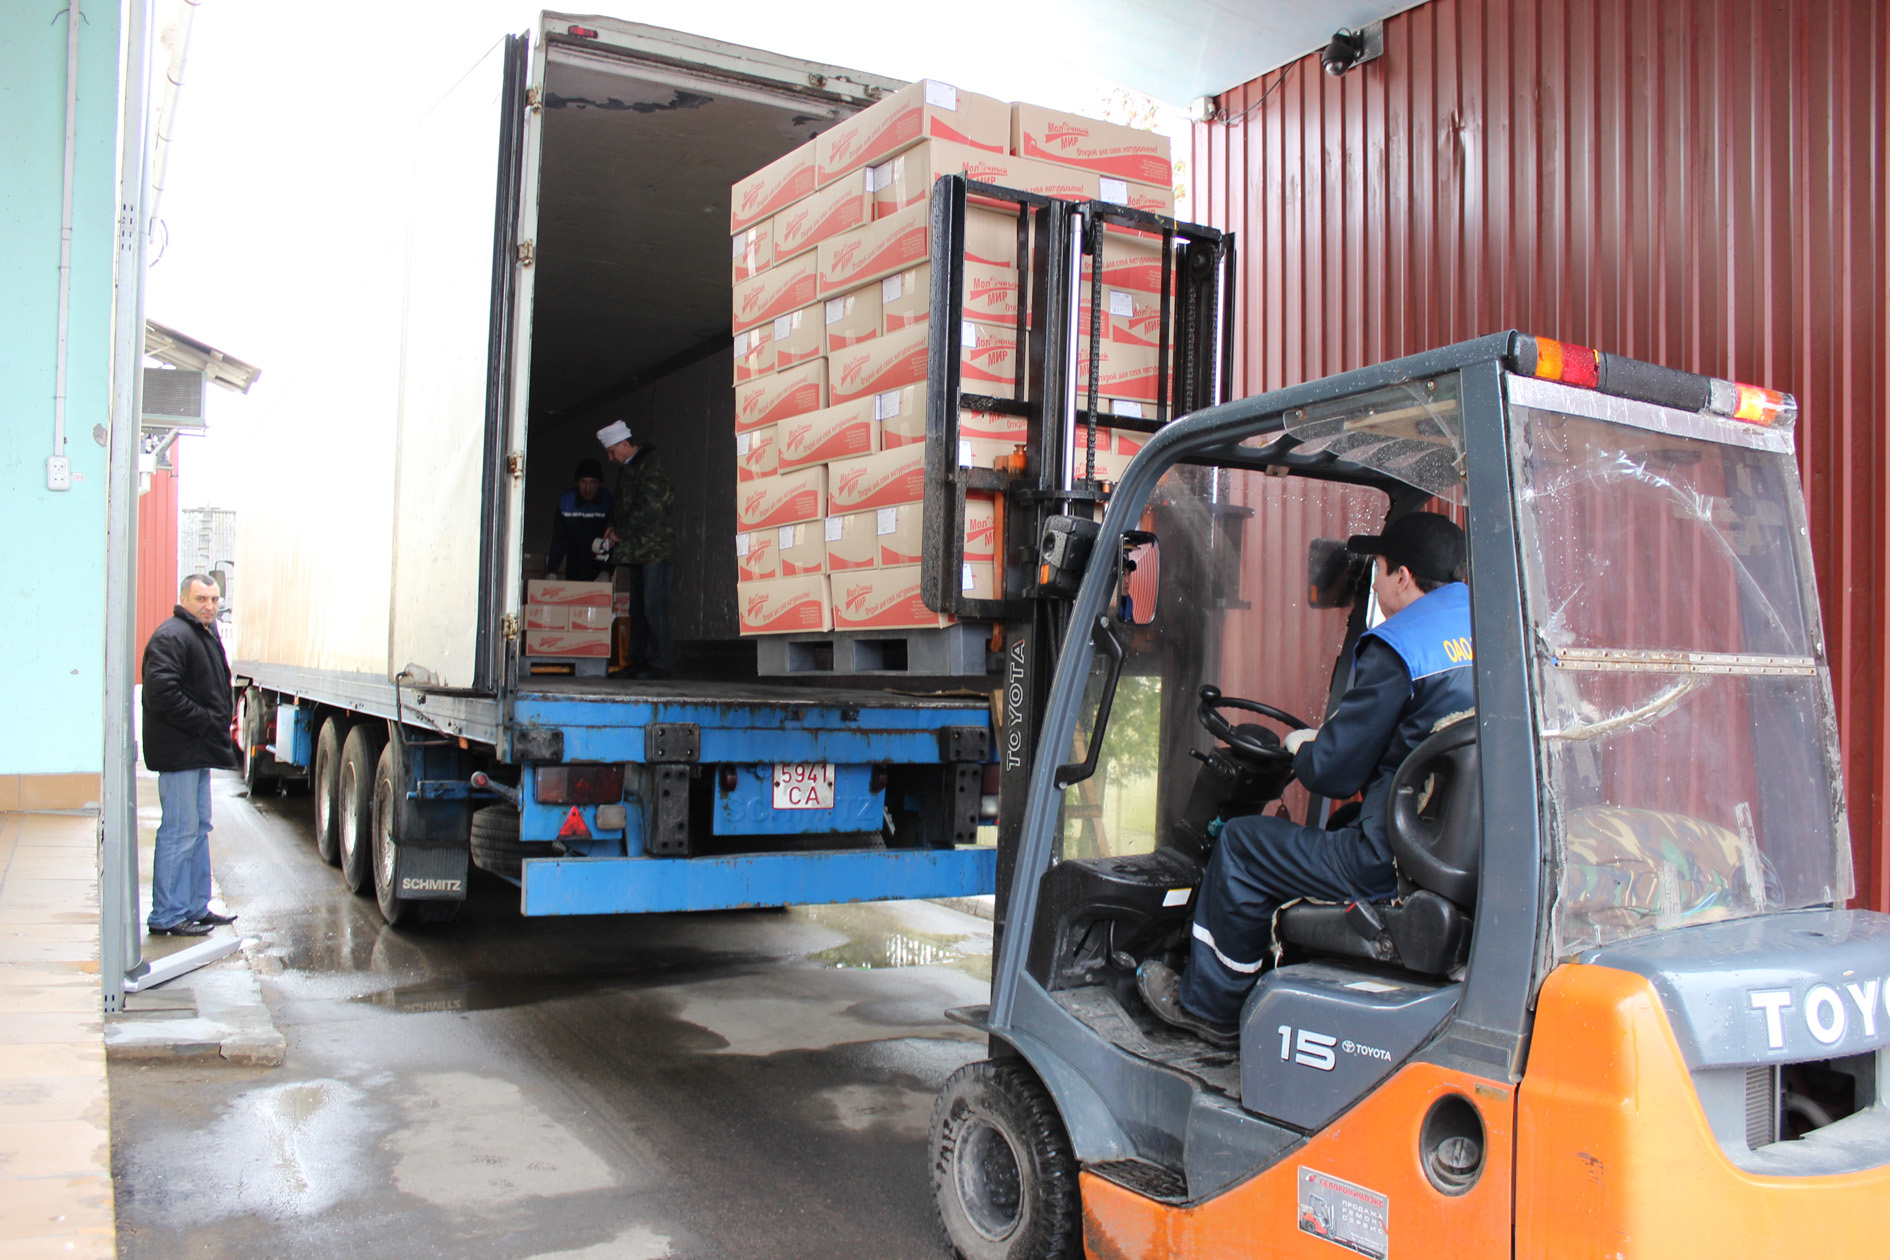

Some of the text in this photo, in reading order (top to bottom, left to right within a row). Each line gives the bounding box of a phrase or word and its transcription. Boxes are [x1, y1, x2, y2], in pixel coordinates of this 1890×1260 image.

[1061, 137, 1078, 150] МИР
[962, 162, 1008, 174] Молочный
[842, 252, 854, 272] МИР
[988, 292, 1007, 306] МИР
[988, 350, 1008, 368] МИР
[850, 366, 862, 386] МИР
[795, 435, 805, 453] МИР
[847, 479, 859, 497] МИР
[754, 604, 764, 620] МИР
[854, 596, 866, 614] МИР
[1444, 637, 1473, 662] ОАО
[1007, 638, 1026, 771] TOYOTA
[782, 764, 827, 784] 5941
[789, 786, 820, 806] CA
[402, 878, 461, 891] SCHMITZ
[1748, 976, 1890, 1049] TOY
[1278, 1025, 1392, 1071] 15 TOYOTA
[1342, 1200, 1383, 1220] ПРОДАЖА
[1342, 1214, 1384, 1234] СЕРВИС
